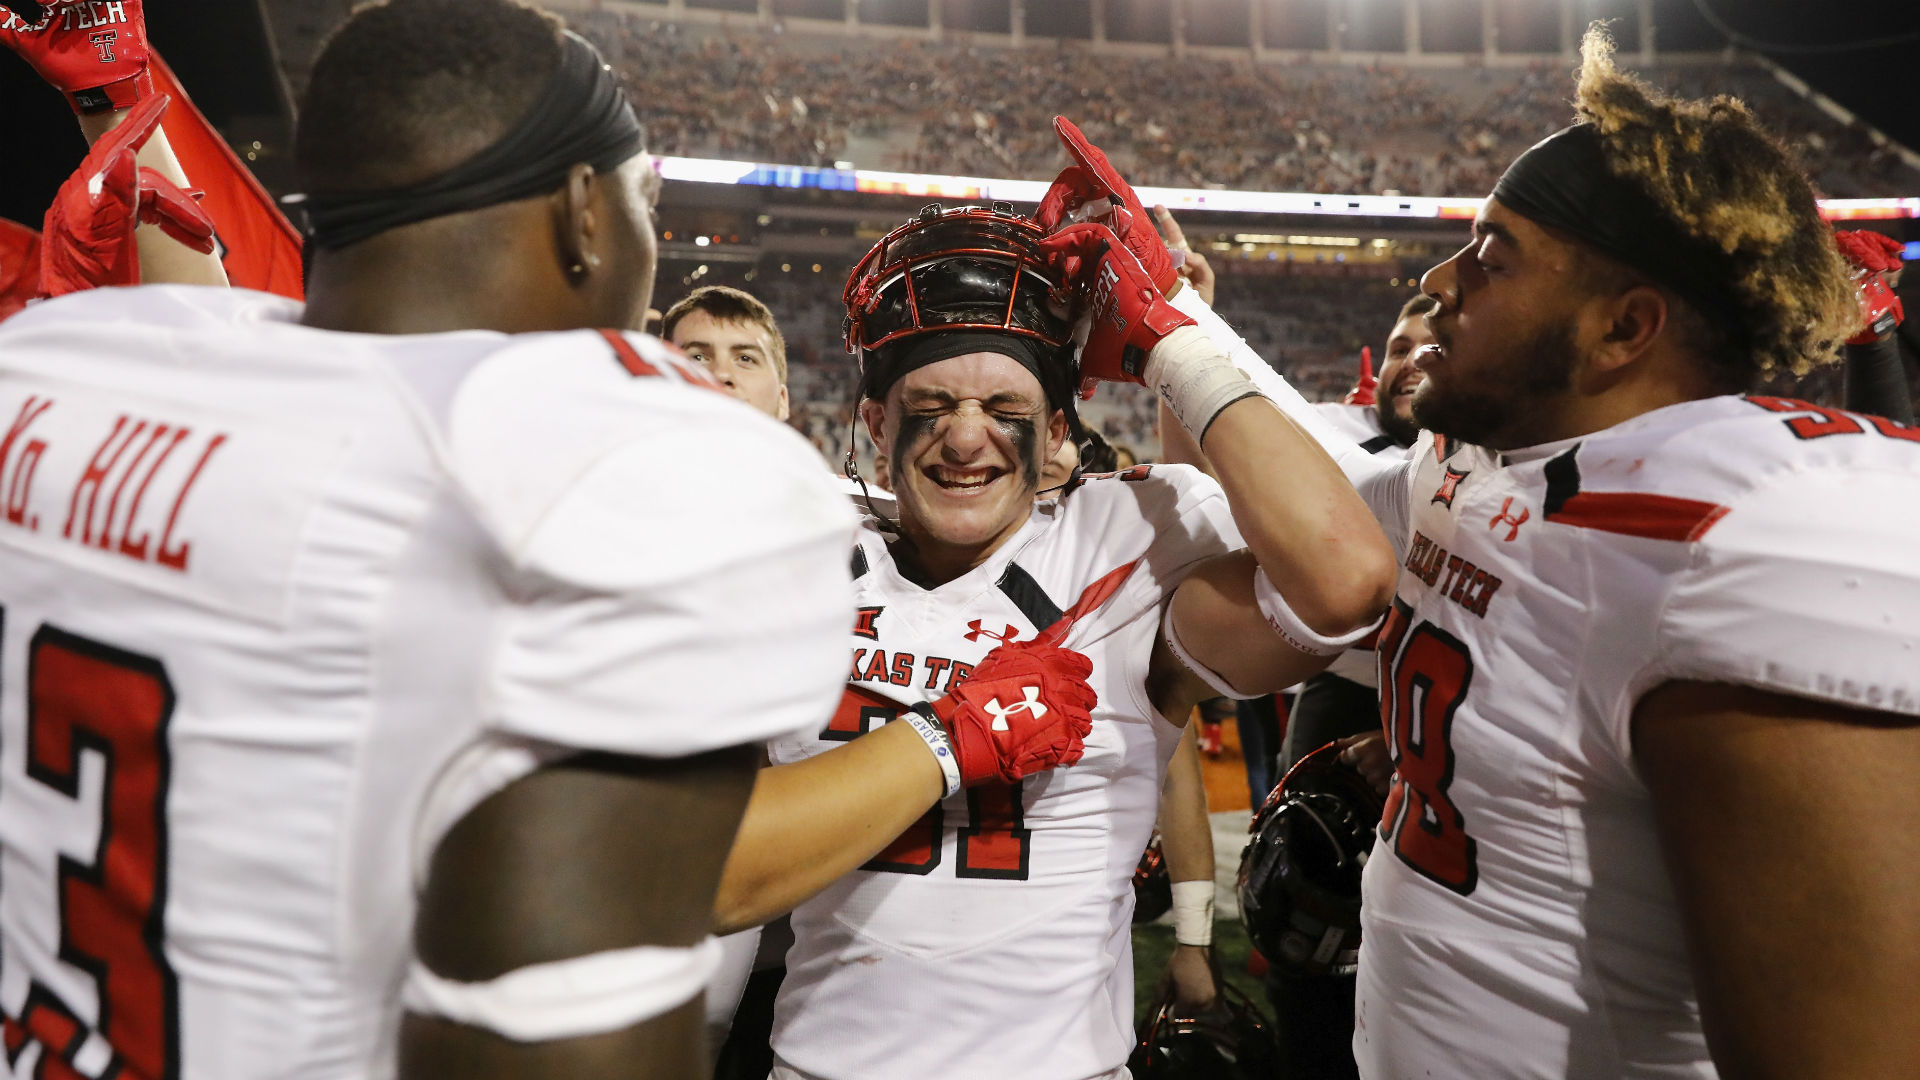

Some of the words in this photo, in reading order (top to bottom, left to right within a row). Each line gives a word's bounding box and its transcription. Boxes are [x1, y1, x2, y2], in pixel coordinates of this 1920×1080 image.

[61, 0, 127, 31] TECH
[62, 414, 228, 571] HILL
[1440, 554, 1503, 619] TECH
[846, 648, 915, 687] XAS
[924, 655, 974, 694] TE
[908, 714, 940, 745] ADAPT
